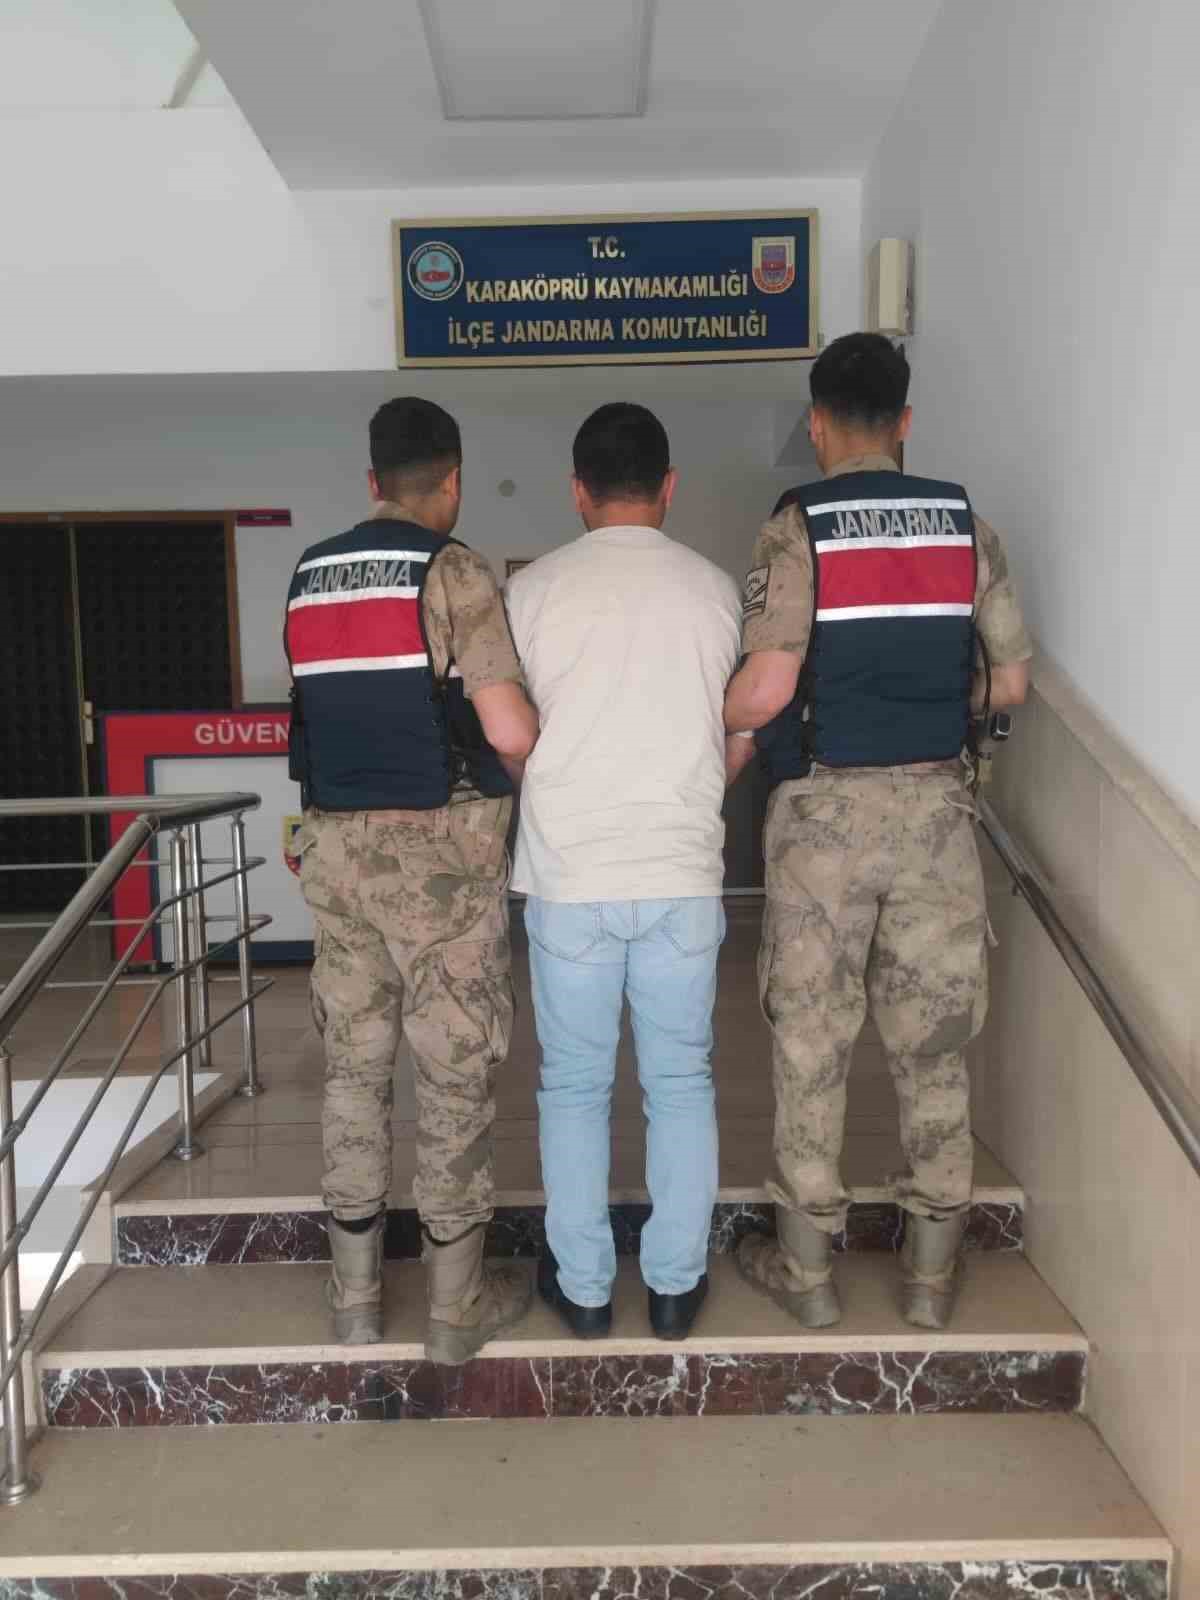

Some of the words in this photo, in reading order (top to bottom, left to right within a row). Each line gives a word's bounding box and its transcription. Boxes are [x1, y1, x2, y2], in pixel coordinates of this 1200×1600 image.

[586, 235, 626, 258] T.C.
[465, 273, 588, 303] KARAKÖPRÜ
[594, 268, 748, 299] KAYMAKAMLIĞI
[448, 316, 495, 350] İLÇE
[501, 318, 615, 344] JANDARMA
[621, 310, 768, 341] KOMUTANLIĞI
[831, 508, 959, 539] JANDARMA
[302, 559, 412, 598] JANDARMA
